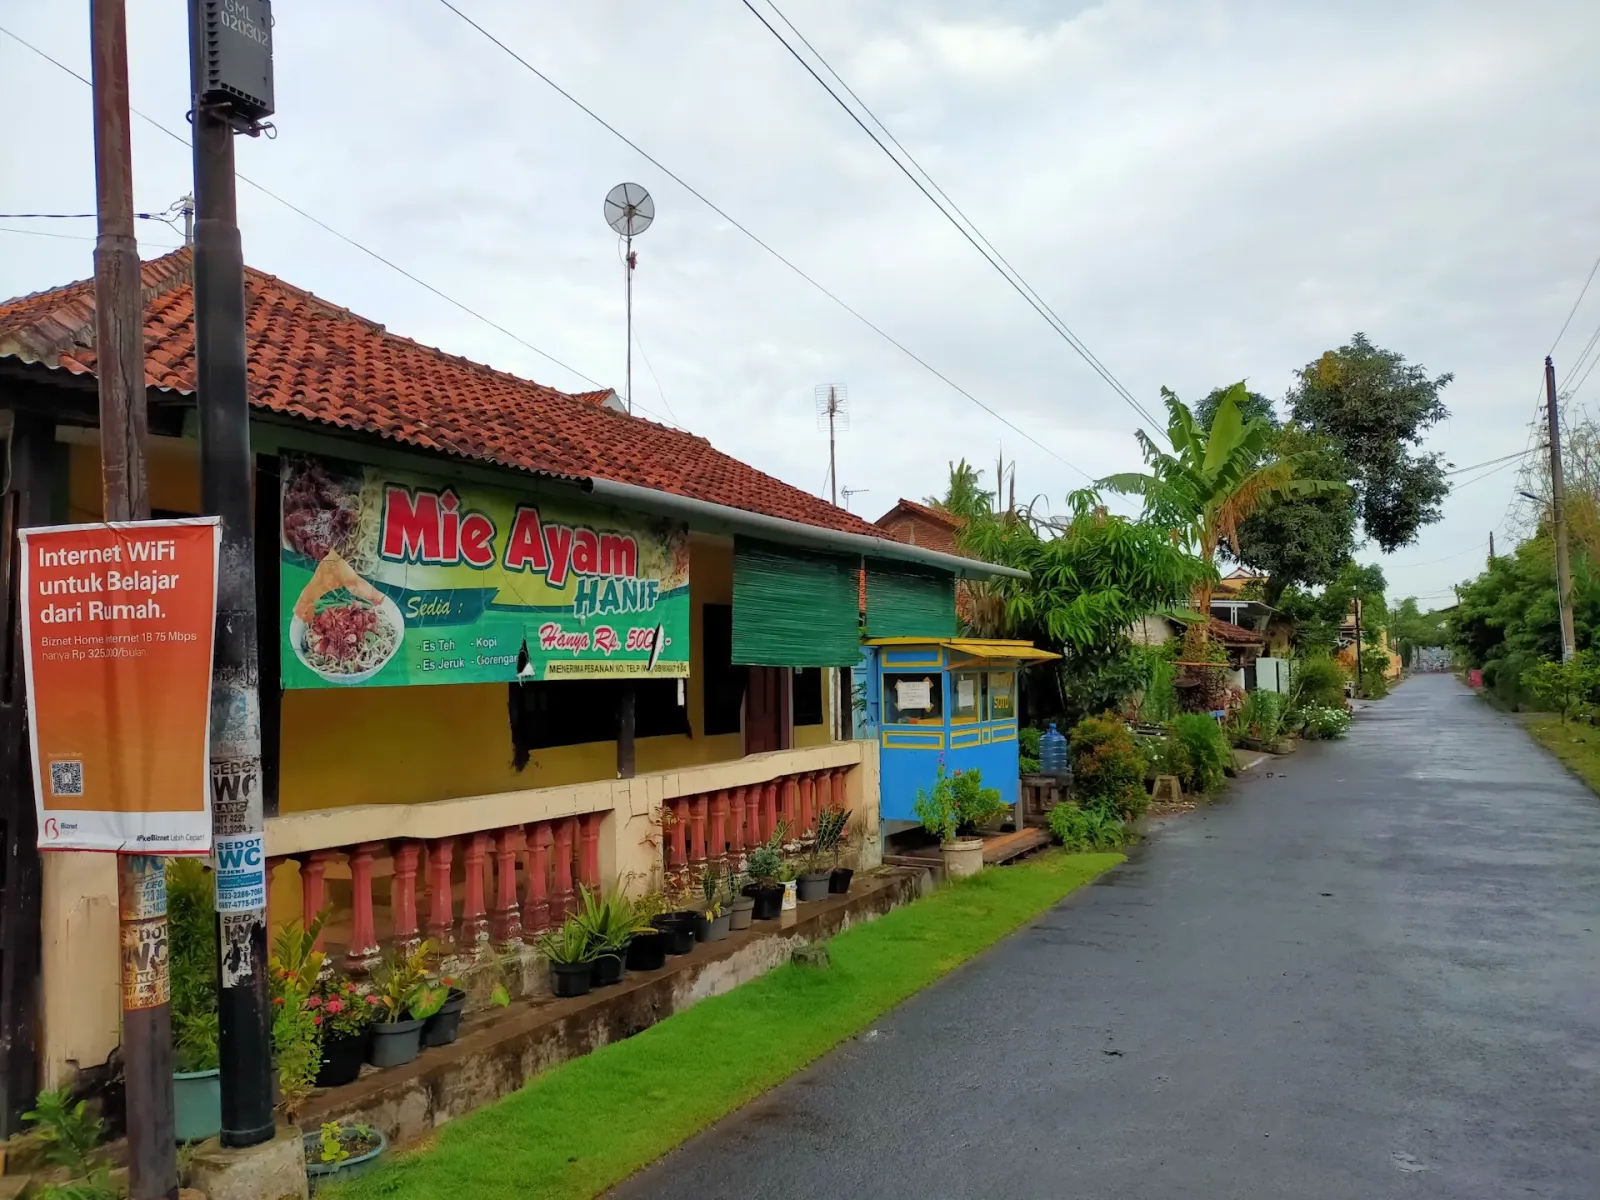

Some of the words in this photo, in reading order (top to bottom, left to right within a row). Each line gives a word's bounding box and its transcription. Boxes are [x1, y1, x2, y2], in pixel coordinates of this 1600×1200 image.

[225, 0, 254, 23] GML
[221, 11, 269, 47] 020302
[381, 487, 495, 566] Mie
[505, 507, 638, 587] Ayam
[39, 544, 122, 567] Internet
[127, 540, 175, 562] WiFi
[39, 572, 104, 596] untuk
[107, 570, 179, 595] Belajar
[405, 595, 452, 619] Sedia
[574, 577, 660, 617] HANIF
[40, 601, 82, 624] dari
[88, 598, 166, 621] Rumah.
[42, 636, 72, 647] Biznet
[74, 635, 104, 645] Home
[155, 632, 166, 642] 75
[168, 631, 197, 644] Mbps
[423, 640, 436, 652] Es
[438, 639, 455, 651] Teh
[476, 636, 497, 649] Kopi
[540, 624, 588, 655] Hanya
[594, 626, 621, 655] Rp.
[42, 651, 70, 662] hanya
[72, 649, 85, 660] Rp
[423, 659, 436, 671] Es
[438, 658, 465, 670] Jeruk
[549, 664, 583, 674] MENERIMA
[584, 664, 614, 674] PESANAN
[217, 838, 260, 850] SEDOT
[218, 847, 261, 869] WC
